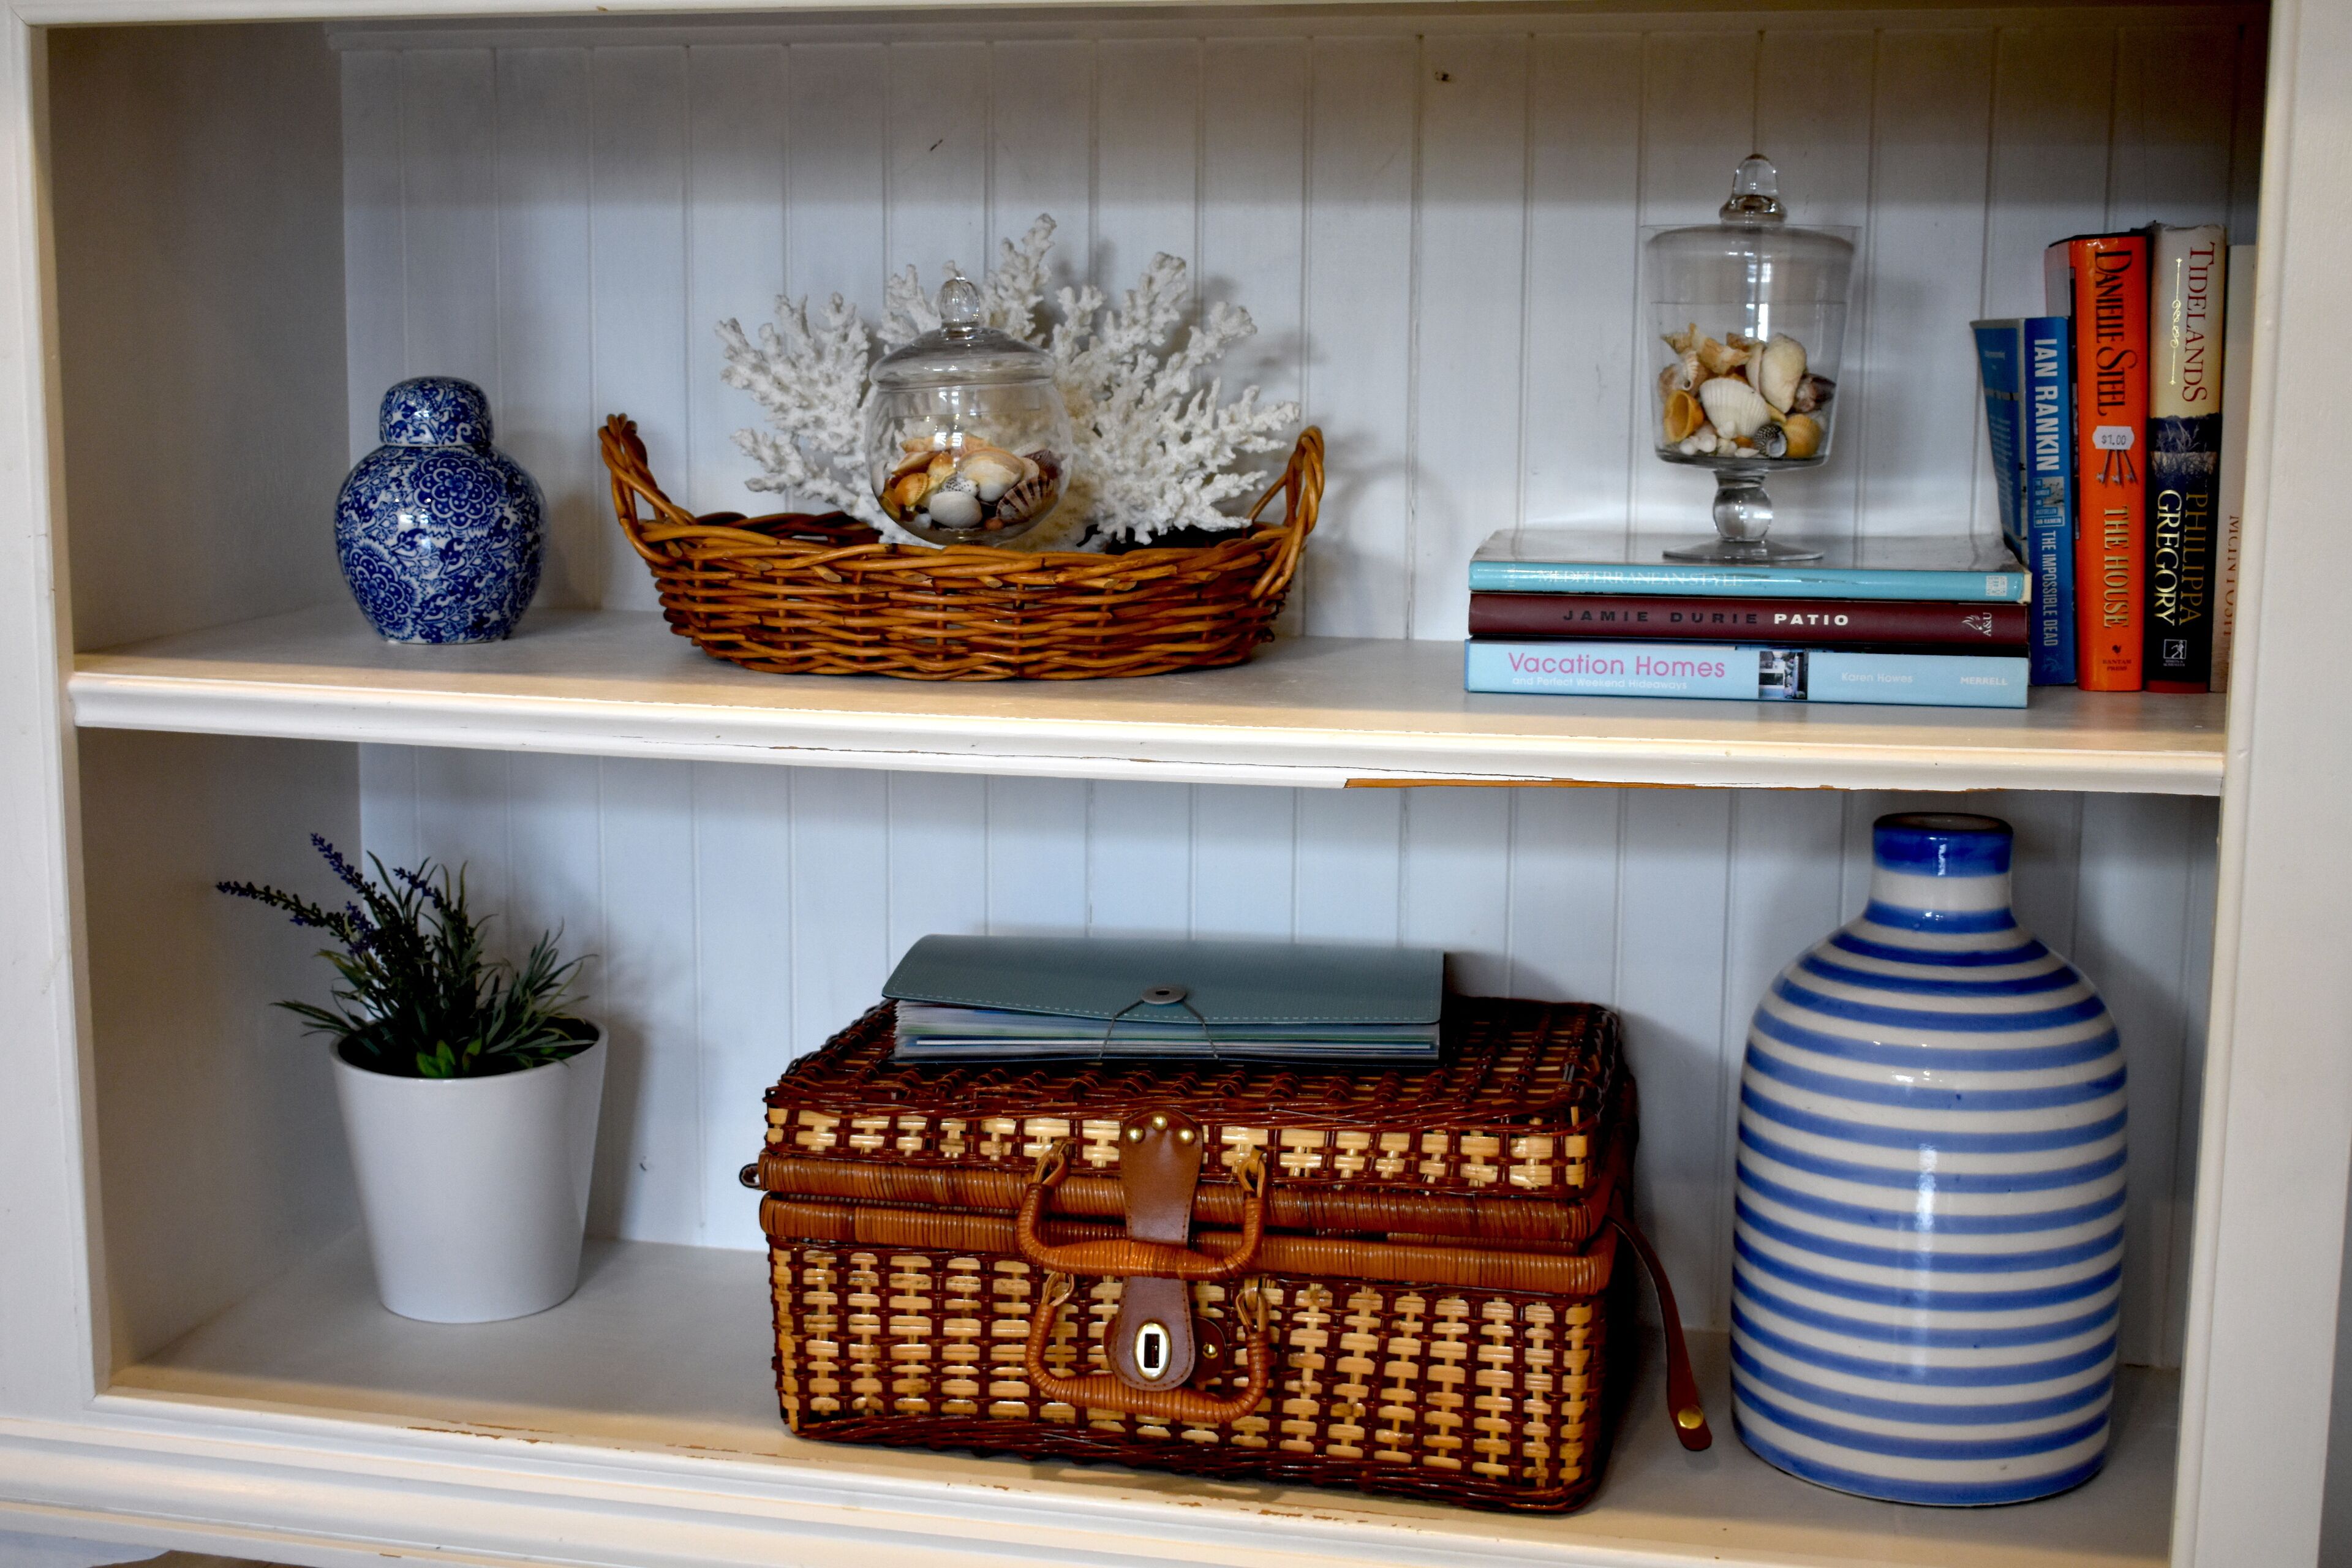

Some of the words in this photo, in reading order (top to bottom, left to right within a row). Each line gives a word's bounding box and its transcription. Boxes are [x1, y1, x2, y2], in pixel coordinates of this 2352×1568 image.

[2094, 250, 2133, 344] DANIELLE
[2181, 242, 2215, 402] TIDELANDS
[2034, 338, 2057, 378] IAN
[2096, 346, 2138, 417] STEEL
[2035, 385, 2060, 471] RANKIN
[2101, 434, 2127, 446] $1.00
[2041, 530, 2056, 551] THE
[2104, 505, 2130, 549] THE
[2154, 489, 2182, 626] GREGORY
[2179, 492, 2209, 626] PHILIPPA
[1538, 570, 1685, 585] MEDITERRANEAN
[1689, 573, 1743, 586] STYLE
[2042, 554, 2058, 616] IMPOSSIBLE
[2104, 554, 2130, 628] HOUSE
[1563, 610, 1649, 622] JAMIE
[1670, 612, 1758, 624] DURIE
[1774, 613, 1849, 626] PATIO
[2043, 618, 2059, 647] DEAD
[1508, 652, 1624, 674] Vacation
[1635, 655, 1725, 678] Homes
[1512, 677, 1534, 685] and
[1537, 677, 1573, 687] Perfect
[1577, 677, 1625, 688] Weekend
[1629, 679, 1687, 690] Hideaways
[1841, 673, 1874, 682] Karen
[1877, 674, 1913, 683] Howes
[1960, 676, 2008, 685] MERRELL
